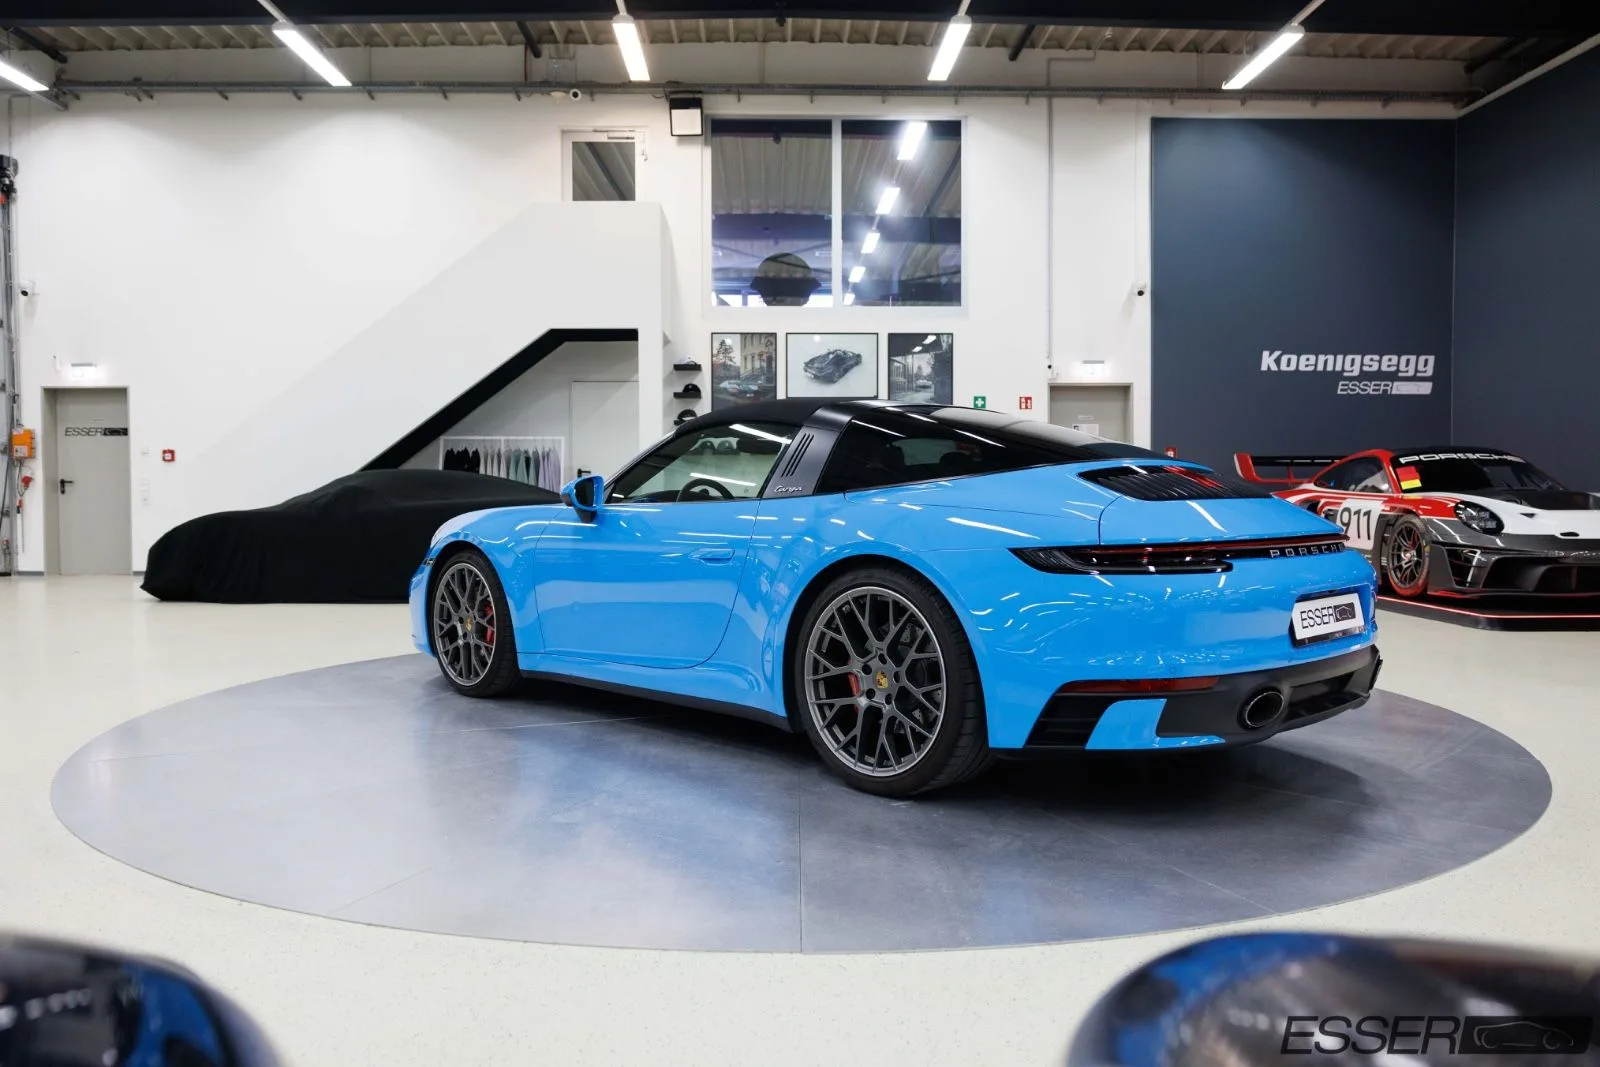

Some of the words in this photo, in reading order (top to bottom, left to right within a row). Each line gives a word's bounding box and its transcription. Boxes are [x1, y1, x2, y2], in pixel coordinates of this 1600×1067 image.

[1260, 350, 1435, 377] Koenigsegg
[1337, 381, 1392, 395] ESSER
[64, 427, 103, 436] ESSER
[1399, 453, 1526, 464] PORSCHE
[1340, 507, 1372, 541] 911
[1269, 544, 1345, 558] PORSCHE
[1300, 606, 1336, 629] ESSER
